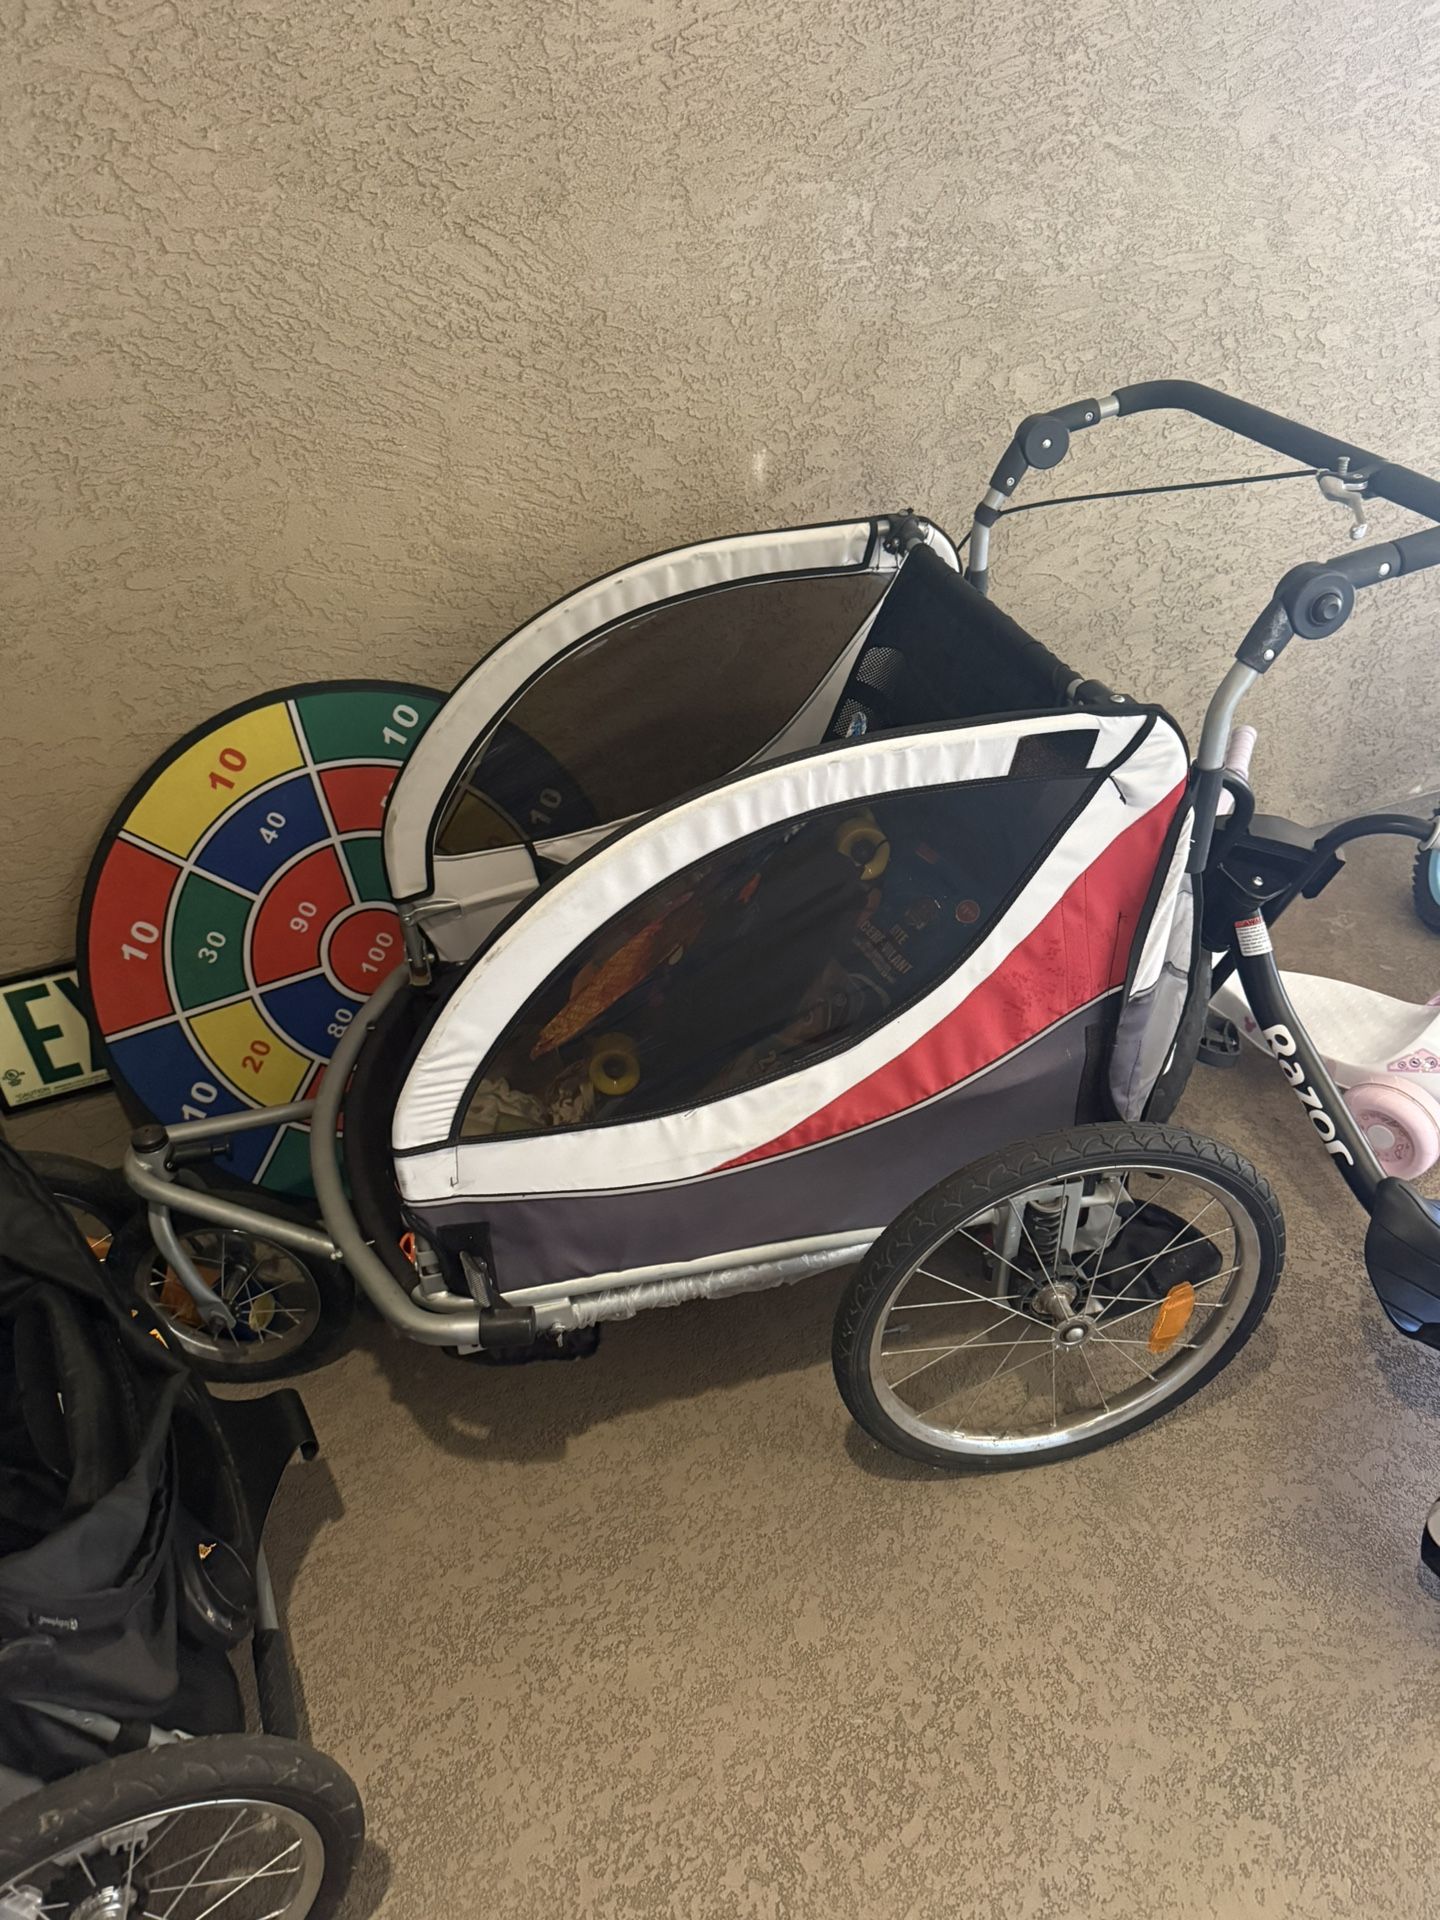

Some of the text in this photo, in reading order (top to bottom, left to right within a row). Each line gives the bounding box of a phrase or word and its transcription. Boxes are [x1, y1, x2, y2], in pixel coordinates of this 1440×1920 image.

[382, 704, 419, 746] 10
[208, 747, 247, 792] 10
[528, 788, 563, 825] 10
[258, 811, 287, 846] 40
[289, 901, 318, 934] 90
[121, 920, 160, 962] 10
[198, 931, 227, 964] 30
[360, 932, 395, 975] 100
[327, 1008, 354, 1039] 80
[241, 1040, 272, 1074] 20
[181, 1082, 218, 1122] 10
[1263, 1024, 1354, 1167] Razor
